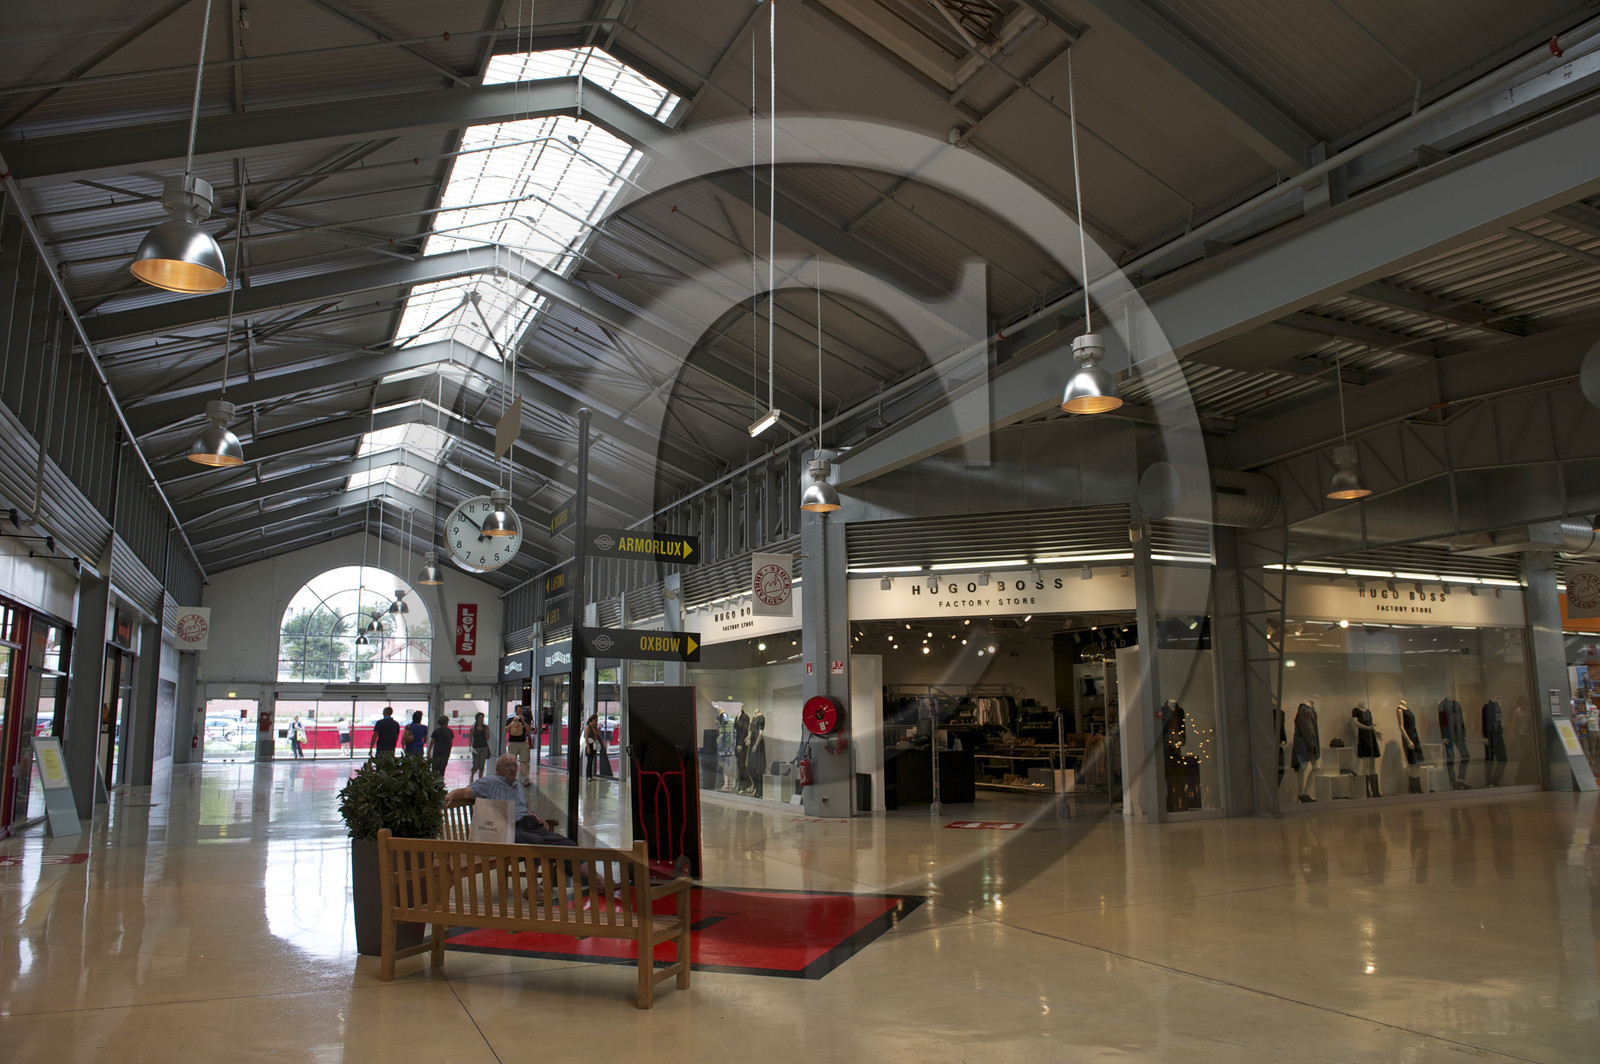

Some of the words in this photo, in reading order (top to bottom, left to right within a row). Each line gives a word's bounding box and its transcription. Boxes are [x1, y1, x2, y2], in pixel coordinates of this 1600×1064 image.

[469, 505, 475, 514] 11
[482, 503, 490, 511] 12
[457, 513, 466, 522] 10
[453, 527, 459, 535] 9
[456, 540, 462, 549] 8
[504, 545, 510, 553] 4
[618, 536, 682, 557] ARMORLUX
[466, 551, 471, 560] 7
[479, 556, 486, 564] 6
[494, 553, 500, 562] 5
[770, 565, 791, 590] STOCK
[911, 582, 977, 596] HUGO
[996, 578, 1063, 592] BOSS
[1359, 588, 1399, 600] HUGO
[1409, 591, 1446, 603] BOSS
[938, 599, 990, 608] FACTORY
[998, 597, 1036, 606] STORE
[1376, 604, 1408, 613] FACTORY
[1411, 606, 1432, 614] STORE
[714, 610, 736, 622] HUGO
[740, 607, 751, 617] BO
[722, 623, 740, 632] FACTORY
[741, 620, 754, 628] STORE
[639, 635, 681, 653] OXBOW
